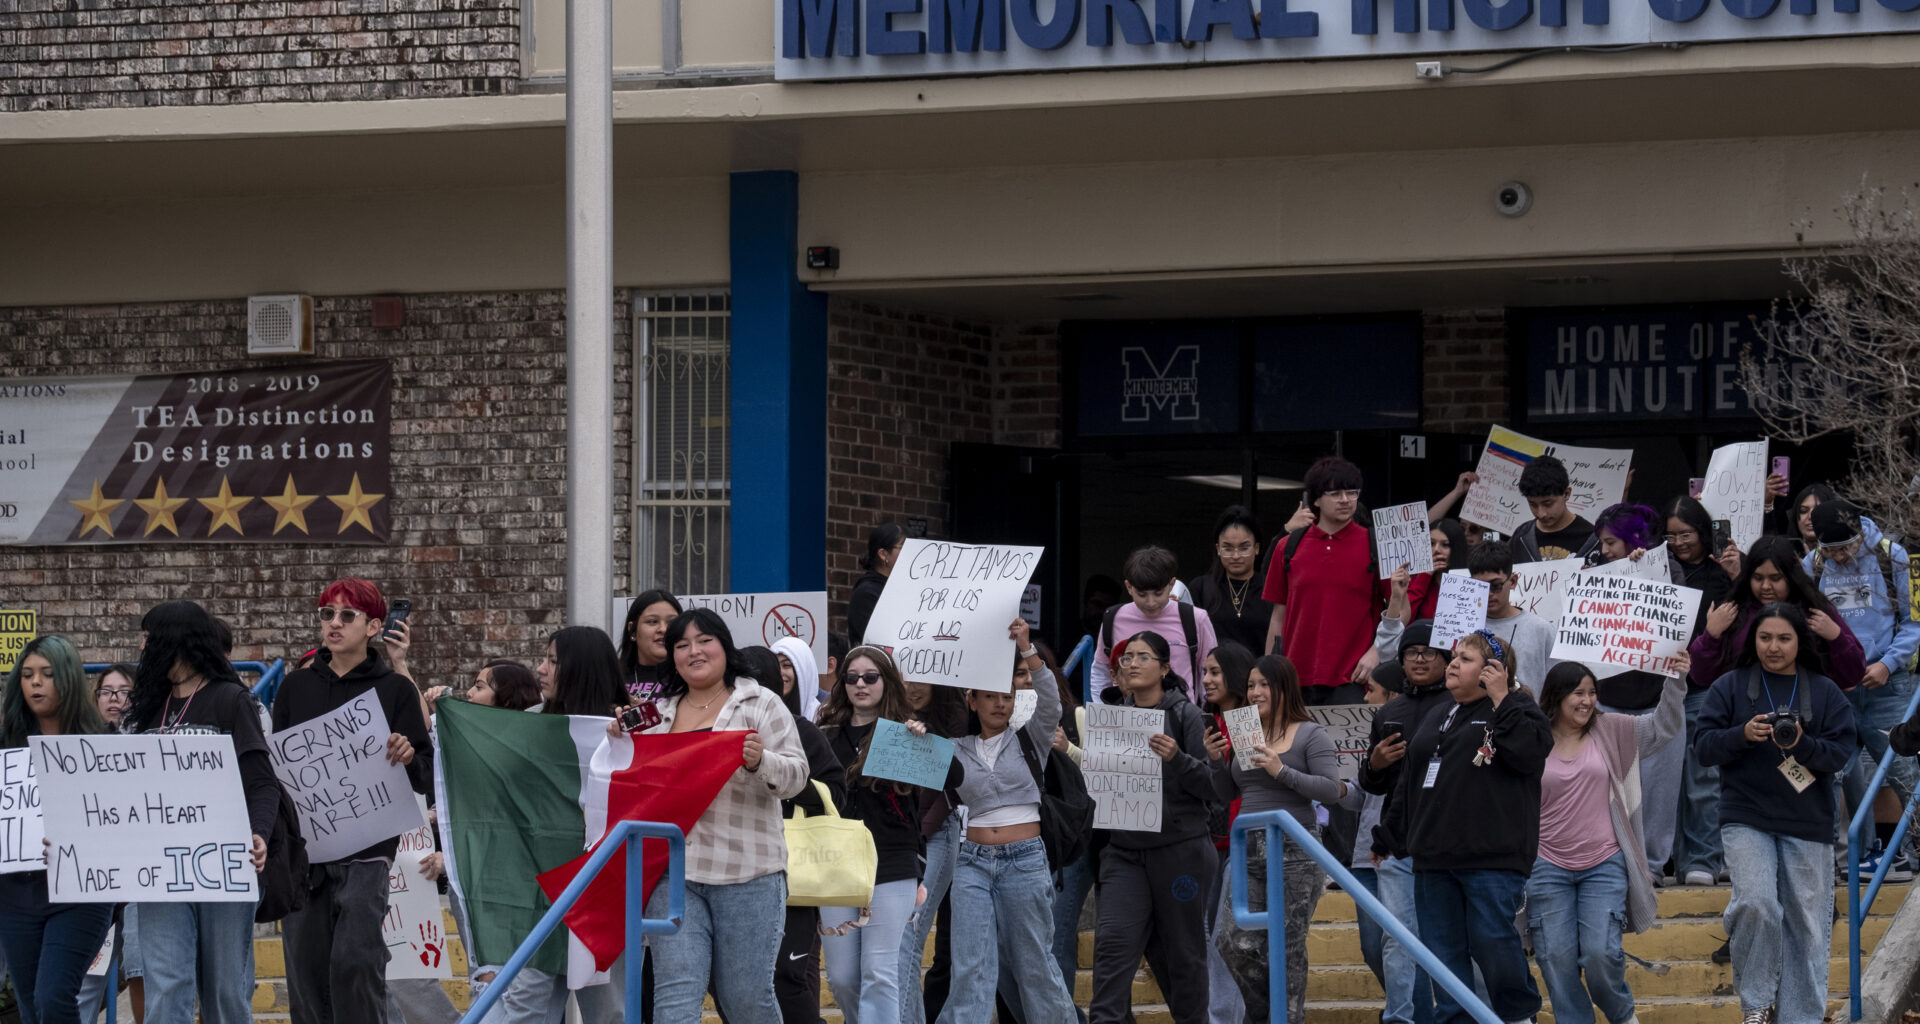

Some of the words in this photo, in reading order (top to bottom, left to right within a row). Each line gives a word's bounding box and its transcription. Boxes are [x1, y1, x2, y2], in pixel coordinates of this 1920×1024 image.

[1557, 324, 1666, 364] HOME
[1690, 321, 1740, 360] OF
[186, 377, 239, 394] 2018
[265, 374, 321, 393] 2019
[1125, 380, 1196, 394] MINUTEMEN
[131, 405, 203, 429] TEA
[215, 403, 375, 427] Distinction
[132, 438, 373, 468] Designations
[1736, 443, 1764, 468] THE
[1569, 461, 1590, 475] you
[1598, 459, 1626, 472] don't
[1707, 469, 1762, 497] POWE
[1374, 509, 1396, 527] OUR
[1396, 503, 1427, 523] VOICES
[1728, 500, 1747, 513] OF
[1377, 527, 1391, 542] CAN
[1391, 523, 1409, 539] ONLY
[1410, 521, 1421, 536] BE
[909, 543, 1033, 581] GRITAMOS
[1379, 540, 1416, 578] HEARD
[1620, 564, 1641, 575] WILL
[1515, 570, 1559, 597] RUMP
[1585, 576, 1604, 588] AM
[1609, 577, 1626, 589] NO
[1629, 580, 1678, 598] LONGER
[918, 587, 949, 612] POR
[953, 589, 982, 611] LOS
[1568, 587, 1619, 599] ACCEPTING
[1622, 591, 1641, 602] THE
[1643, 593, 1683, 610] THINGS
[1569, 598, 1575, 613] I
[1578, 599, 1632, 616] CANNOT
[1634, 605, 1687, 626] CHANGE
[899, 620, 927, 640] QUE
[936, 620, 962, 638] NO
[1561, 615, 1566, 627] I
[1569, 616, 1589, 629] AM
[1592, 618, 1654, 635] CHANGING
[1657, 624, 1687, 641] THE
[1559, 630, 1602, 646] THINGS
[1603, 633, 1608, 647] I
[1611, 634, 1658, 654] CANNOT
[899, 647, 963, 678] PUEDEN!
[1088, 705, 1125, 728] DON'T
[1131, 710, 1163, 727] FORGET
[1232, 707, 1254, 721] FIGHT
[1309, 706, 1377, 727] ISTO
[1088, 730, 1111, 748] THE
[1113, 731, 1145, 748] HANDS
[1233, 732, 1264, 749] FUTURE
[1340, 726, 1370, 740] IS
[41, 741, 77, 774] NO
[80, 739, 146, 773] DECENT
[158, 739, 223, 772] HUMAN
[337, 734, 383, 770] the
[1082, 749, 1120, 772] BUILT
[1131, 757, 1161, 776] CITY
[1133, 749, 1152, 759] THIS
[1127, 776, 1162, 792] FORGET
[83, 793, 120, 827] HAS
[128, 806, 140, 823] A
[144, 793, 206, 824] HEART
[1098, 797, 1158, 828] LAMO
[55, 844, 120, 895] MADE
[137, 866, 162, 887] OF
[164, 842, 250, 893] ICE
